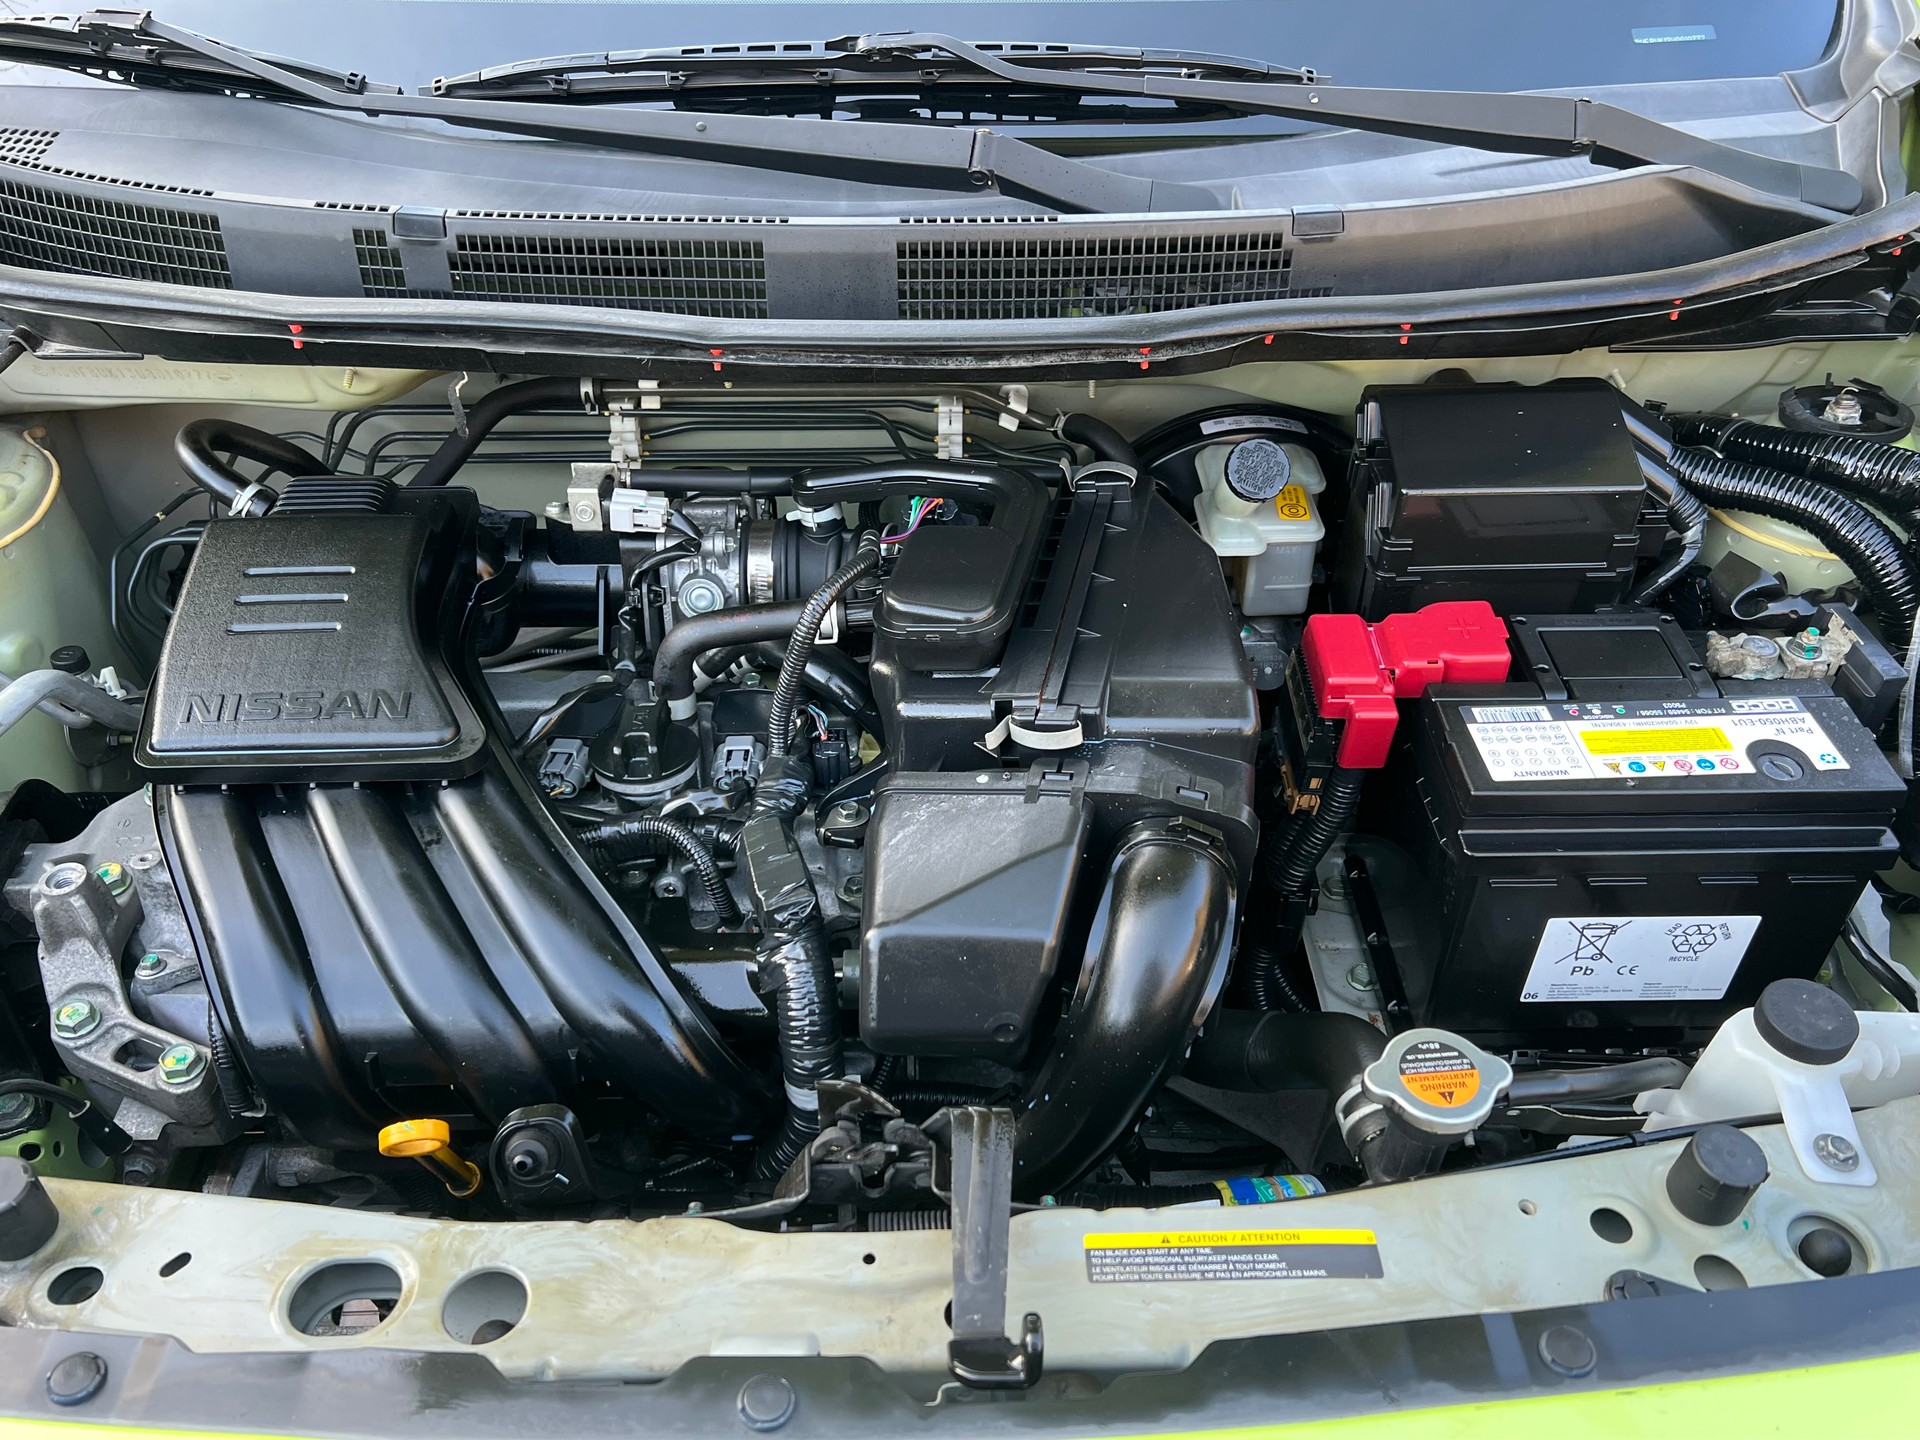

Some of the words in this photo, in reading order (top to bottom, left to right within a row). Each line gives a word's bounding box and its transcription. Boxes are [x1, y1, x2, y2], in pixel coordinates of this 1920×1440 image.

[179, 691, 412, 724] NISSAN
[1730, 716, 1806, 727] ABH050-EU1
[1788, 726, 1814, 735] Part
[1665, 923, 1682, 935] LEAD
[1718, 923, 1733, 941] RETURN
[1570, 966, 1594, 976] Pb
[1523, 992, 1539, 1000] 06
[1406, 1072, 1474, 1083] AVERTISSEMENT
[1420, 1081, 1467, 1091] WARNING
[1178, 1234, 1228, 1243] CAUTION
[1240, 1233, 1300, 1242] ATTENTION
[1122, 1256, 1144, 1264] AVOID
[1149, 1264, 1175, 1272] RISQUE
[1188, 1262, 1228, 1271] DÉMARRER
[1093, 1273, 1114, 1281] POUR
[1115, 1272, 1139, 1280] ÉVITER
